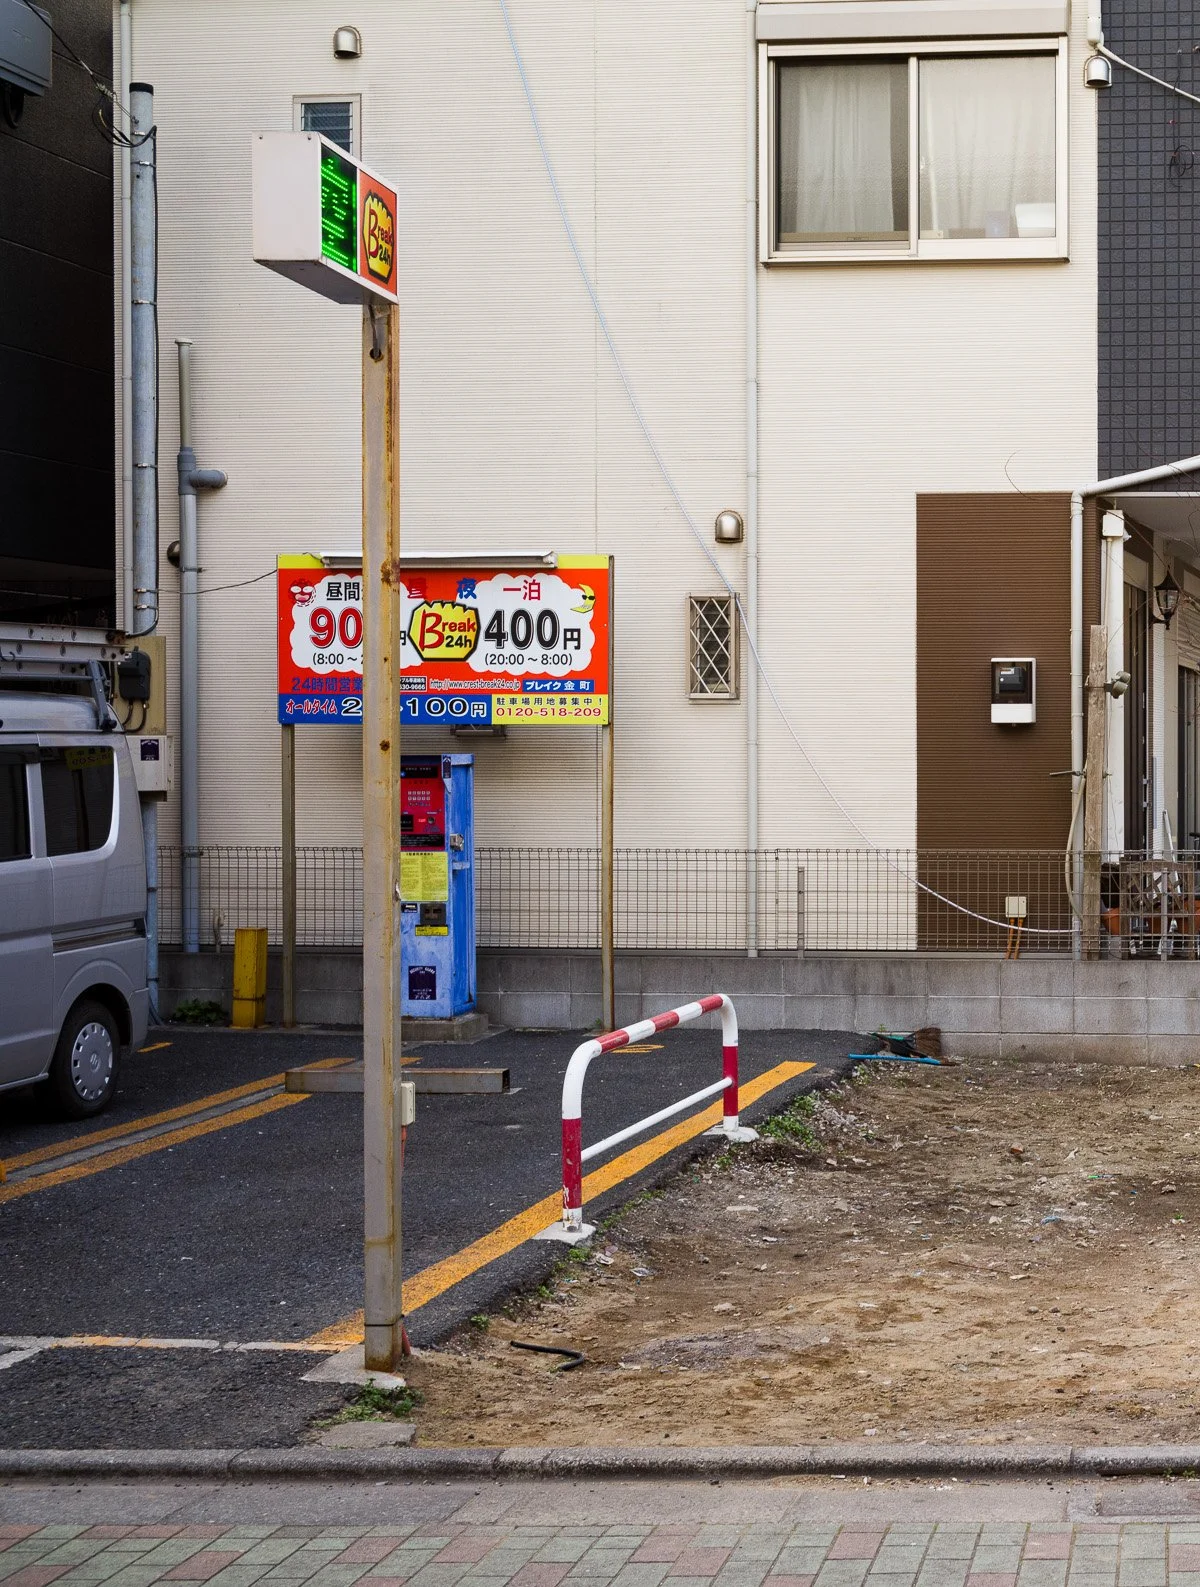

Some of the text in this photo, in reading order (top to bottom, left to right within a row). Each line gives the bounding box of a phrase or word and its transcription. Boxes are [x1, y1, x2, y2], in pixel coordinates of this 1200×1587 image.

[368, 203, 392, 258] Break
[326, 581, 363, 601] 昼間
[456, 577, 477, 599] 夜
[502, 579, 531, 601] 一泊
[418, 609, 476, 651] Break
[484, 608, 581, 650] 400円
[445, 635, 473, 649] 24h
[286, 699, 337, 715] オールタイム
[496, 707, 601, 716] 0120-518-209
